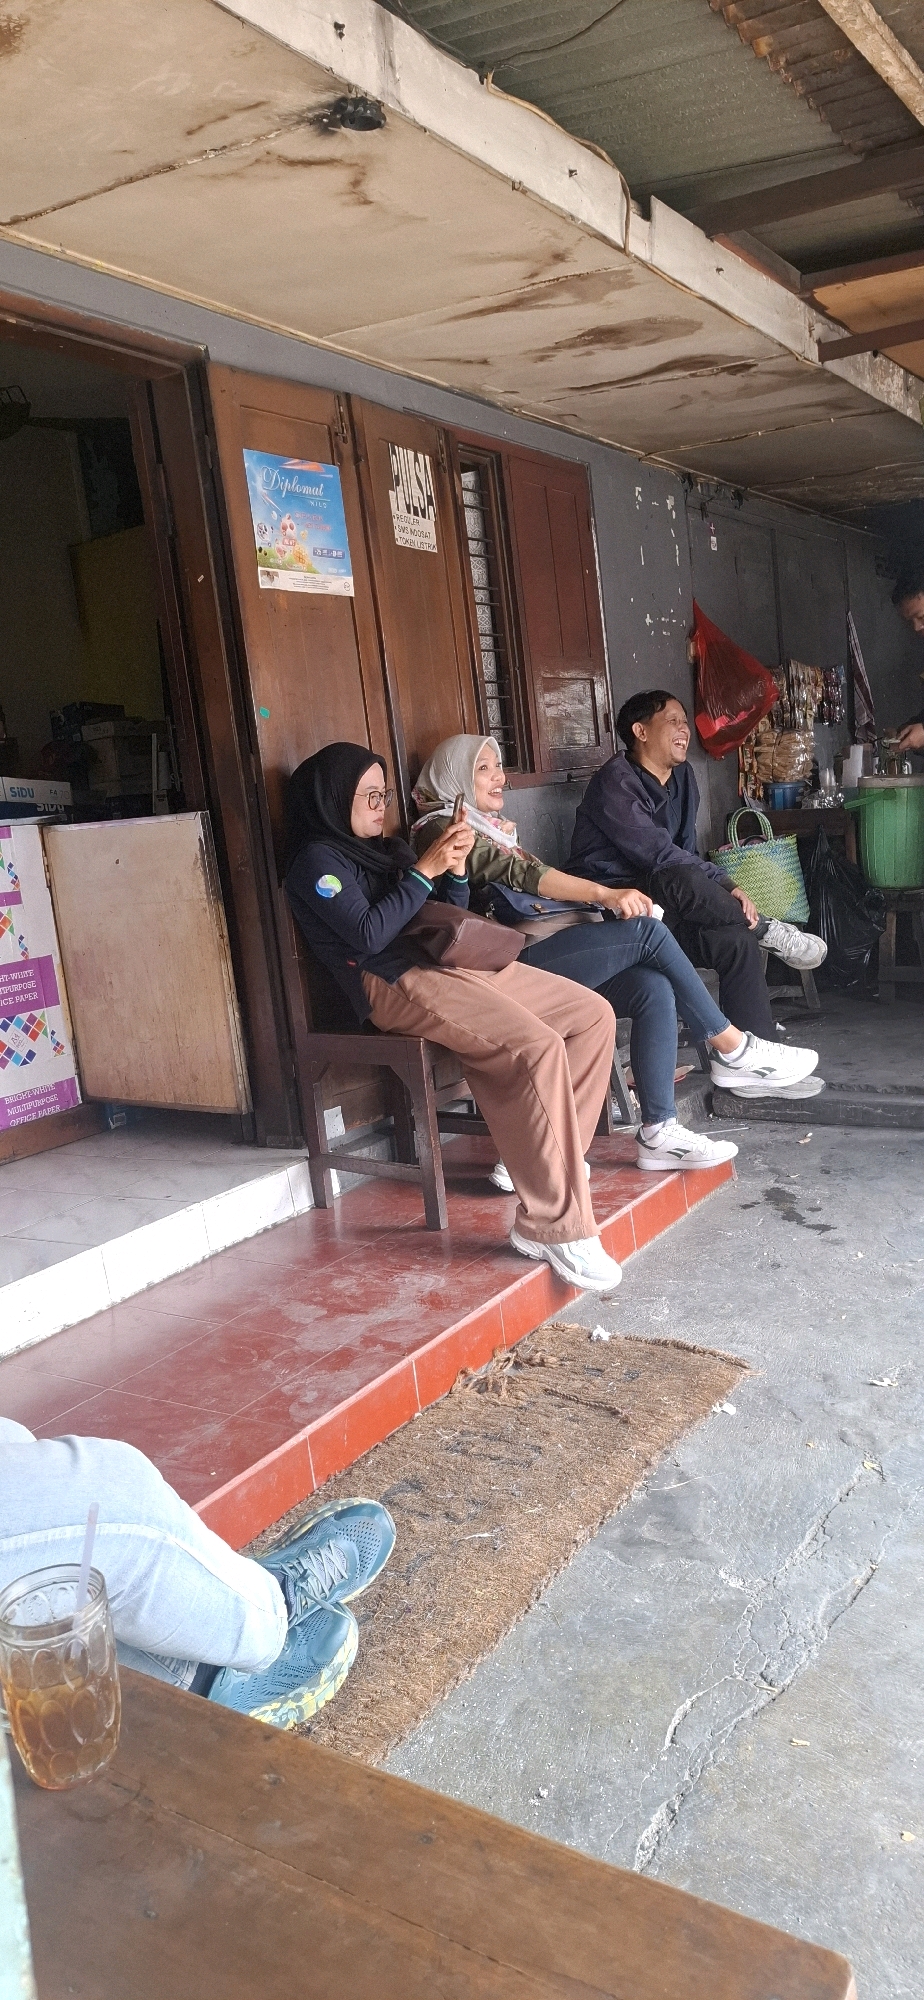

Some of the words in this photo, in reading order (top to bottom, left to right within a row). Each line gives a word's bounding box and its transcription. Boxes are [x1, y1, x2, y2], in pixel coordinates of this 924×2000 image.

[261, 465, 324, 498] Diplomat
[389, 443, 437, 521] PULSA
[396, 514, 420, 526] REGULER
[397, 525, 409, 535] SMS
[399, 536, 416, 548] TOKEN
[15, 991, 39, 1003] PAPER
[7, 1093, 59, 1117] MULTIPURPOSE
[9, 1111, 38, 1127] OFFICE
[37, 1104, 61, 1118] PAPER
